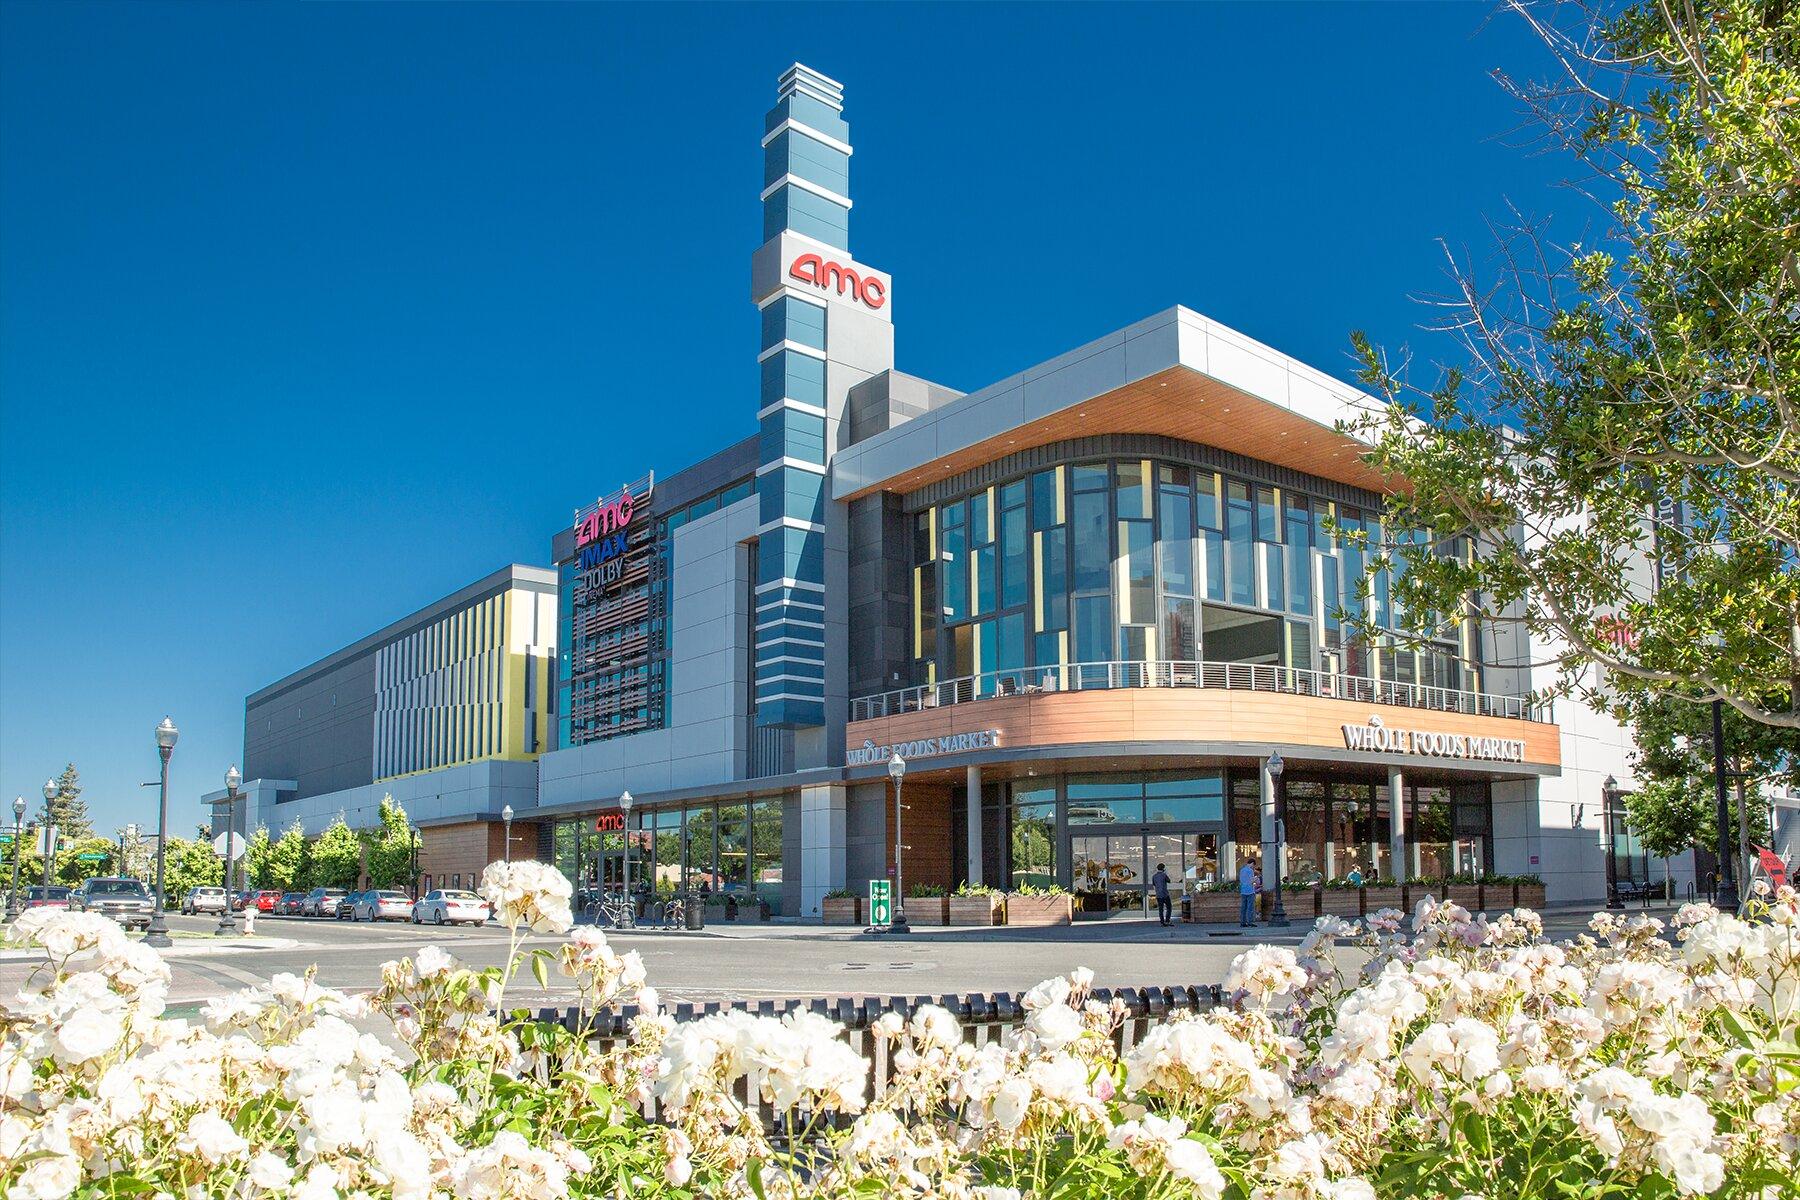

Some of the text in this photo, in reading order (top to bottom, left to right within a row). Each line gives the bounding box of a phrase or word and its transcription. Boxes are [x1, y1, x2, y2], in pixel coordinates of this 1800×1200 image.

[579, 528, 629, 571] IMAX
[583, 558, 624, 592] DOLBY
[847, 729, 1000, 766] WHOLE FOODS MARKET
[1341, 724, 1527, 764] WHOLE FOODS MARKET
